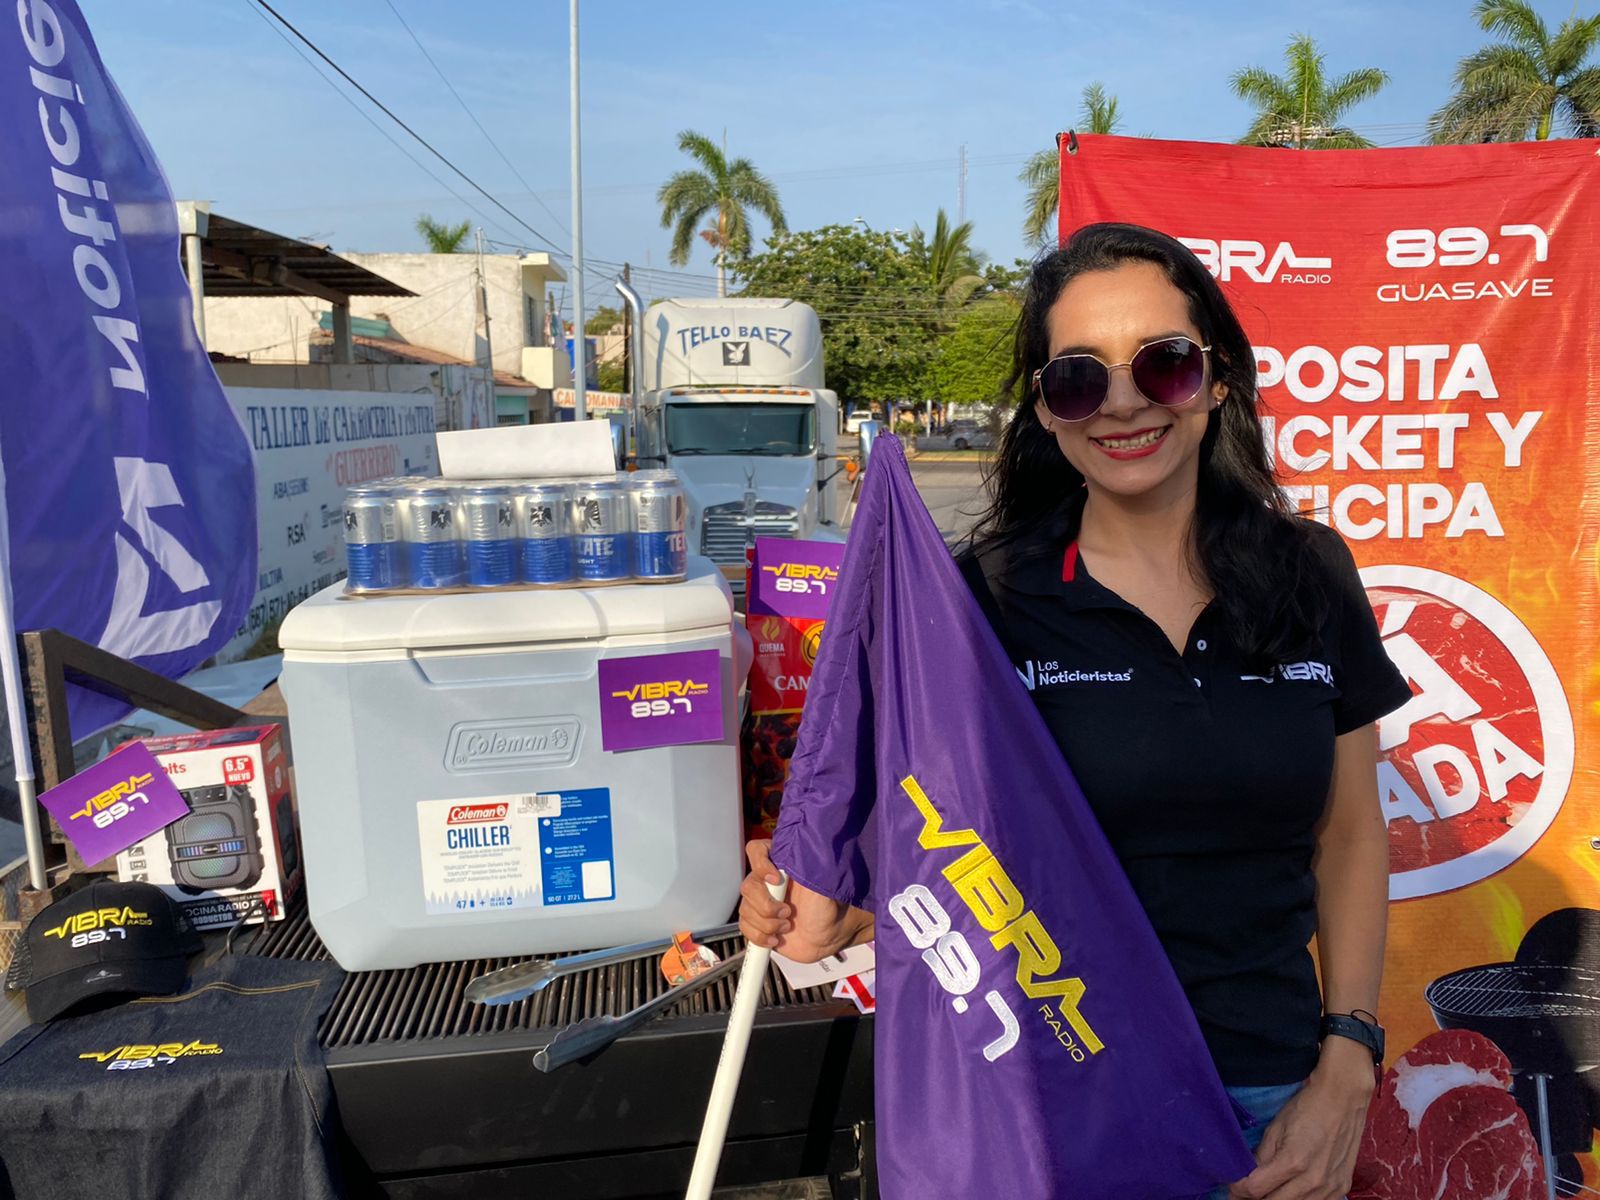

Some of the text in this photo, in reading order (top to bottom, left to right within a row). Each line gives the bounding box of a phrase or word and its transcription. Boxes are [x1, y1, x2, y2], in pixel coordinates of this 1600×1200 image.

[1385, 223, 1548, 269] 89.7
[1281, 273, 1332, 284] RADIO
[1377, 277, 1554, 302] GUASAVE
[677, 326, 793, 358] TELLO BAEZ
[1251, 342, 1500, 403] POSITA
[556, 389, 634, 409] CALOMANIAS
[246, 405, 311, 450] TALLER
[1260, 411, 1544, 473] ICKET Y
[1278, 481, 1505, 541] TICIPA
[287, 523, 306, 547] RSA
[763, 563, 838, 580] VIBRA
[776, 578, 826, 595] 89.7
[759, 643, 785, 653] QUEMA
[613, 680, 709, 702] VIBRA
[631, 698, 693, 719] 89.7
[467, 731, 548, 758] Coleman
[228, 772, 251, 782] NUEVO
[1376, 719, 1545, 828] ADA
[70, 773, 152, 821] VIBRA
[93, 792, 150, 829] 89.7
[451, 805, 497, 821] Coleman
[447, 825, 511, 849] CHILLER
[218, 900, 250, 913] RADIO
[456, 900, 467, 909] 47
[900, 775, 1105, 1056] VIBRA
[44, 906, 149, 940] VIBRA
[127, 917, 153, 927] RADIO
[71, 928, 127, 949] 89.7
[888, 884, 1021, 1062] 89.7
[1038, 1004, 1085, 1062] RADIO
[79, 1040, 220, 1063] VIBRA
[107, 1056, 177, 1071] 89.7
[184, 1047, 224, 1057] RADIO
